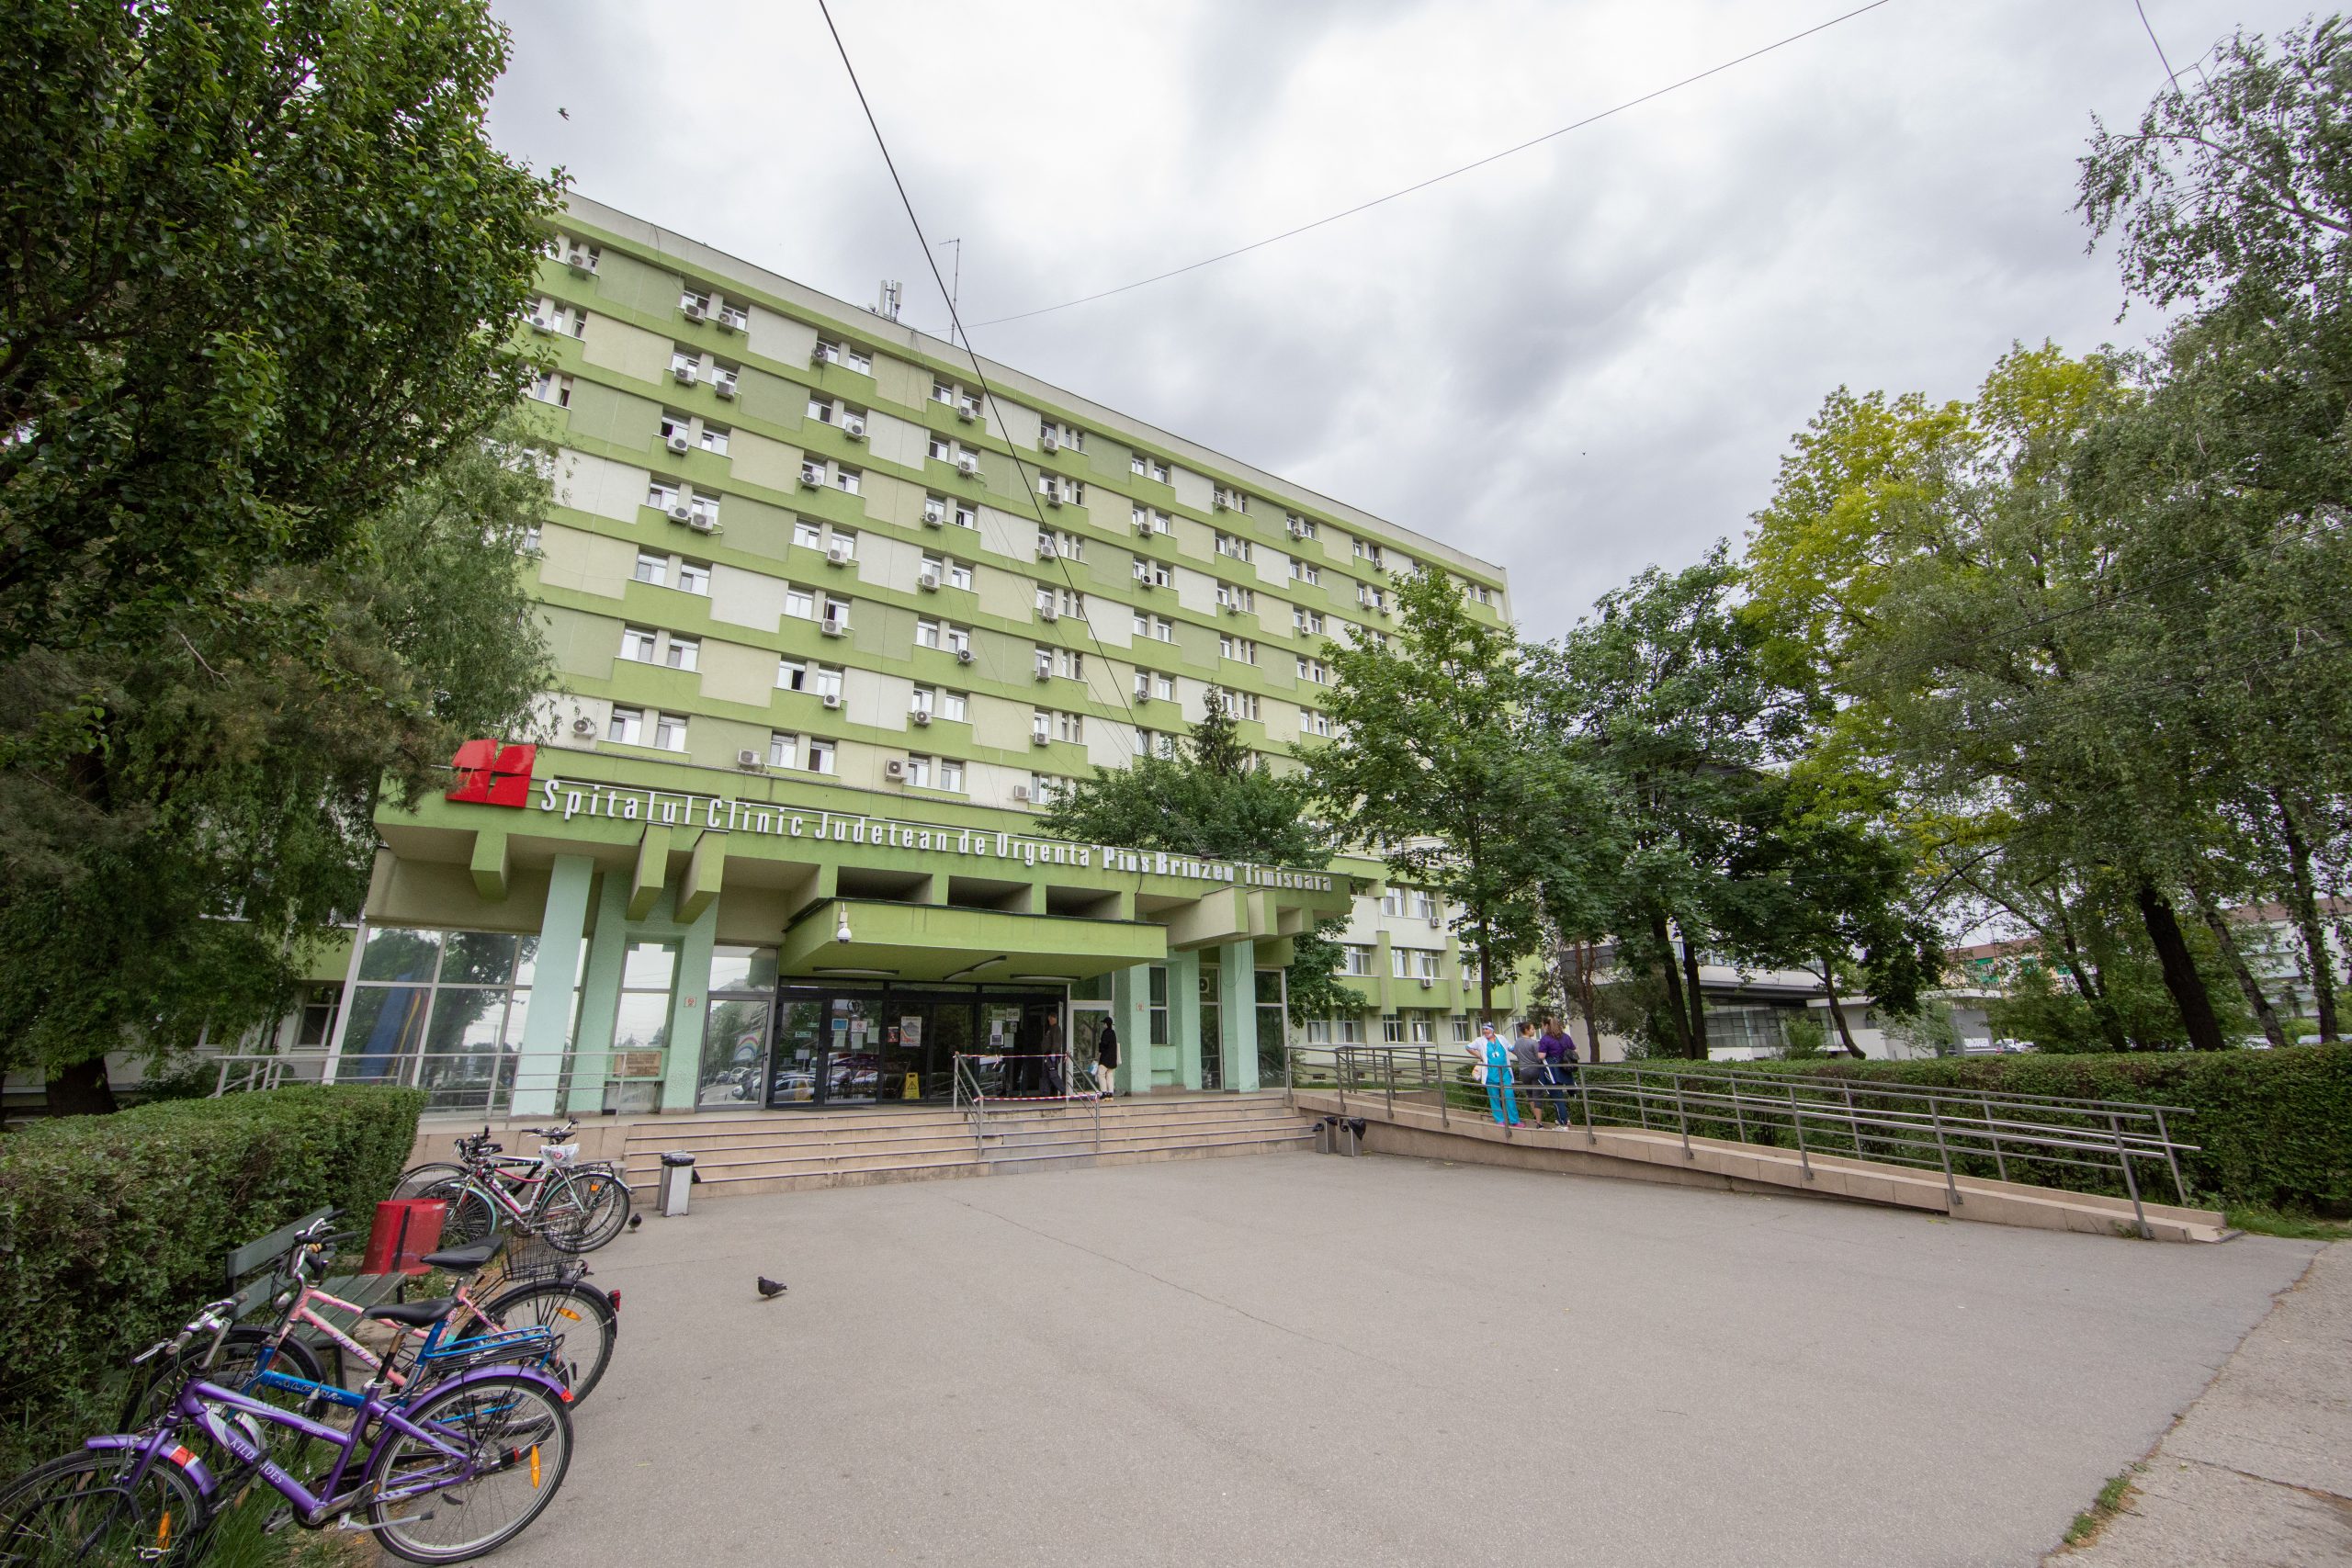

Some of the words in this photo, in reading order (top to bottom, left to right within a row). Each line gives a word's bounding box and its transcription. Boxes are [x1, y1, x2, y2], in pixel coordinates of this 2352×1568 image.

[539, 779, 694, 825] Spitalul
[707, 798, 803, 837] Clinic
[814, 812, 947, 852] Judetean
[957, 829, 986, 856] de
[995, 832, 1090, 867] Urgenta
[1244, 863, 1332, 892] Timisoara
[281, 1380, 340, 1401] ALPNA
[230, 1438, 285, 1484] KILDOES
